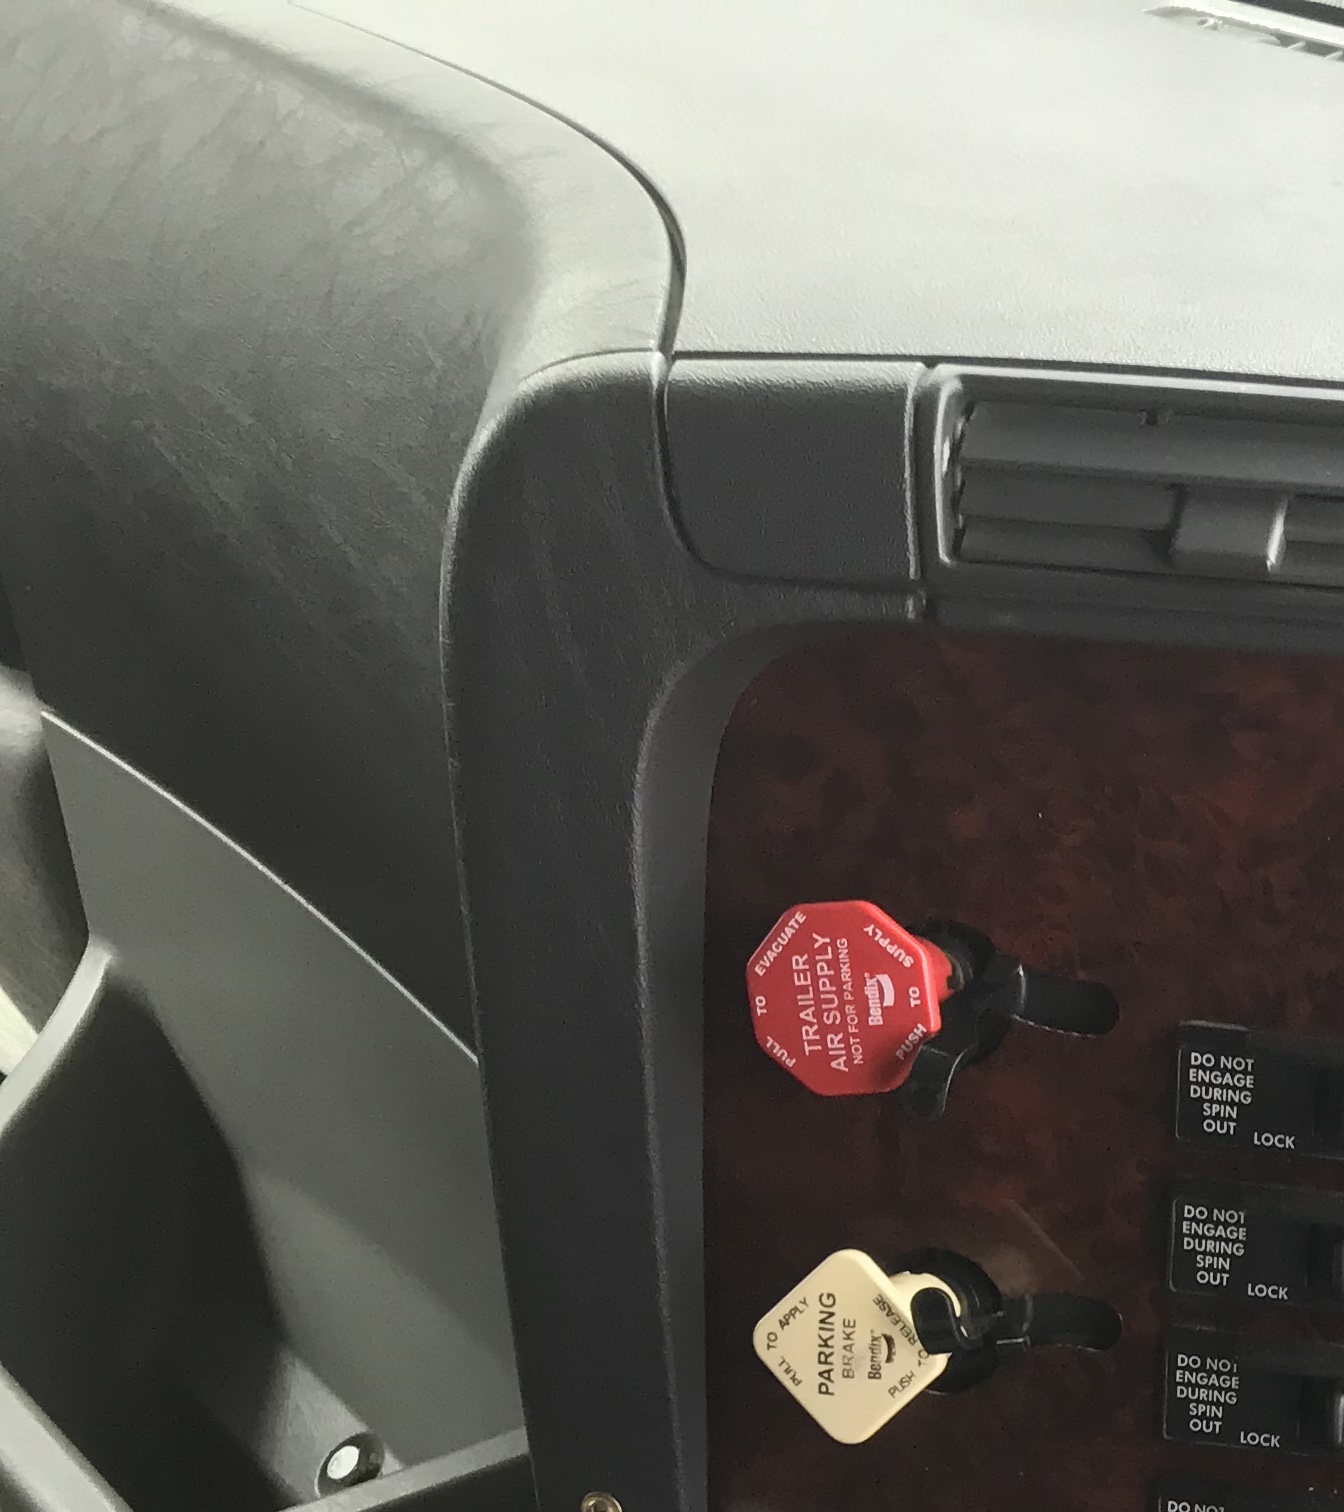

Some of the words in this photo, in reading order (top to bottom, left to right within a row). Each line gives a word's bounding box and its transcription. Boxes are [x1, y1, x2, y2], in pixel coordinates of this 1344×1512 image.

[754, 911, 807, 977] EVACUATE
[863, 923, 914, 970] SUPPLY
[835, 938, 856, 1000] PARKING
[812, 932, 843, 1027] SUPPLY
[756, 995, 767, 1016] TO
[792, 953, 823, 1057] TRAILER
[865, 973, 884, 1026] Bendix
[909, 986, 922, 1008] TO
[846, 1004, 860, 1034] FOR
[829, 1031, 849, 1072] AIR
[851, 1035, 864, 1065] NOT
[895, 1022, 927, 1061] PUSH
[766, 1036, 796, 1069] PULL
[1190, 1052, 1215, 1067] DO
[1220, 1055, 1255, 1071] NOT
[1189, 1069, 1254, 1089] ENGAGE
[1190, 1085, 1252, 1105] DURING
[1202, 1102, 1238, 1119] SPIN
[1202, 1119, 1236, 1135] OUT
[1253, 1132, 1295, 1149] LOCK
[1183, 1205, 1208, 1220] DO
[1182, 1221, 1247, 1240] ENGAGE
[1183, 1237, 1244, 1256] DURING
[1196, 1254, 1230, 1271] SPIN
[1196, 1271, 1229, 1287] OUT
[1247, 1283, 1288, 1299] LOCK
[778, 1296, 811, 1331] APPLY
[872, 1293, 919, 1346] RELEASE
[766, 1331, 777, 1351] TO
[818, 1292, 837, 1397] PARKING
[841, 1318, 857, 1379] BRAKE
[868, 1332, 883, 1380] Bendix
[917, 1348, 930, 1368] TO
[1177, 1353, 1201, 1368] DO
[777, 1356, 803, 1387] PULL
[1175, 1370, 1240, 1389] ENGAGE
[888, 1370, 915, 1399] PUSH
[1176, 1386, 1238, 1405] DURING
[1189, 1402, 1223, 1419] SPIN
[1189, 1419, 1222, 1434] OUT
[1240, 1431, 1280, 1448] LOCK
